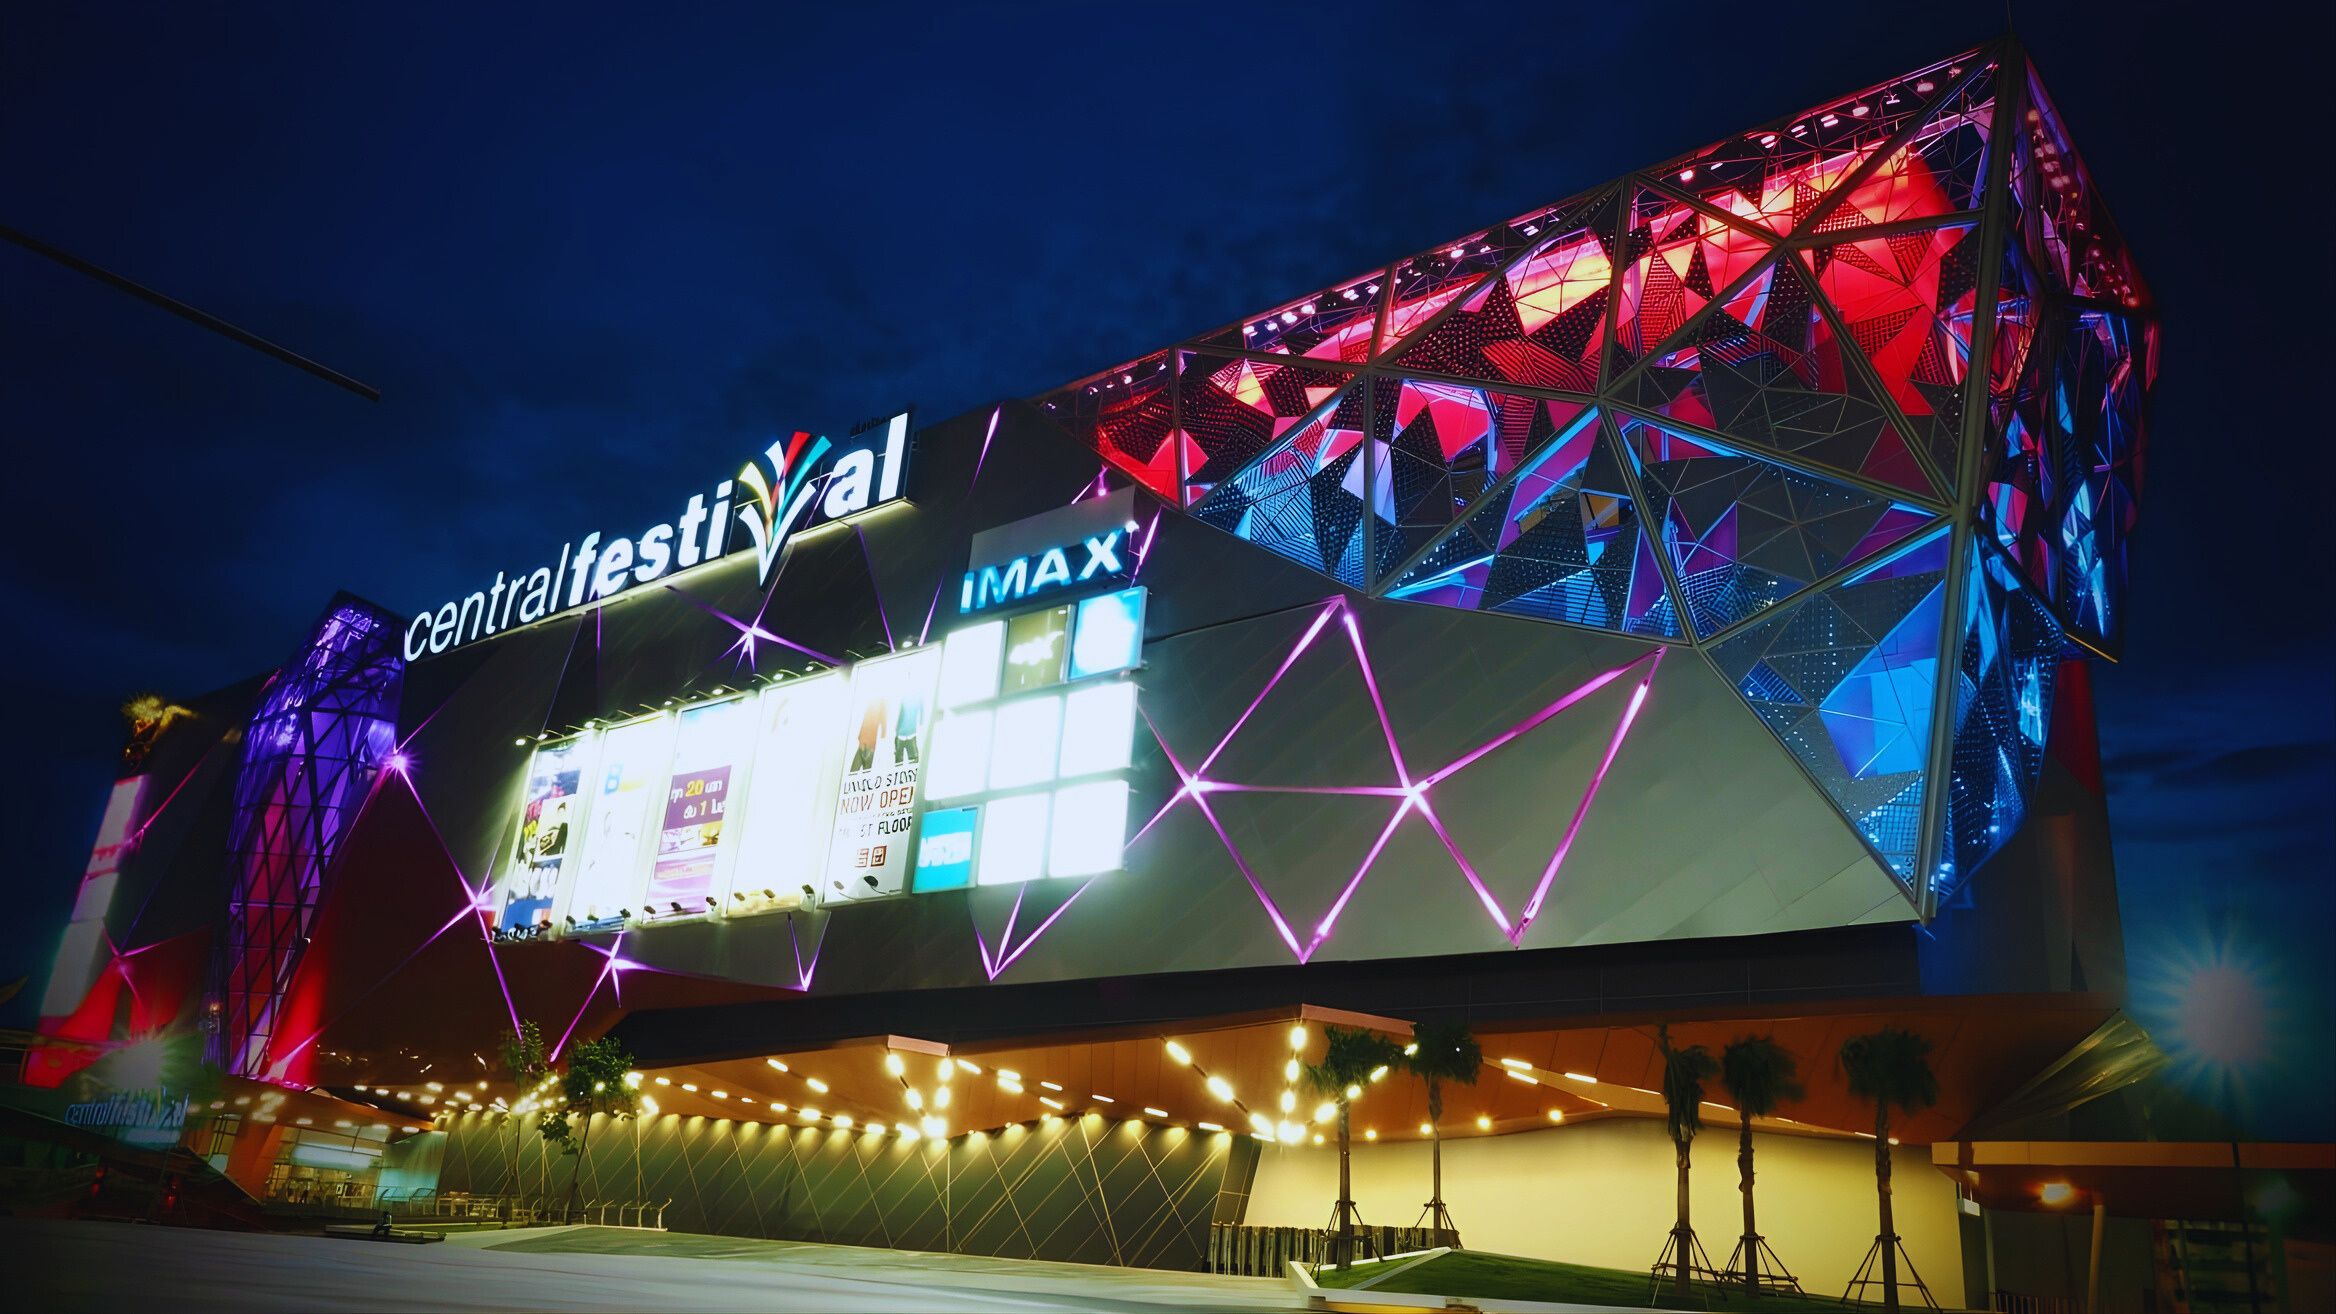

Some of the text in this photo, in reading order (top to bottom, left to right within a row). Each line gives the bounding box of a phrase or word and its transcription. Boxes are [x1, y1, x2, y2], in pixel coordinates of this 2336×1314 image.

[960, 528, 1126, 613] IMAX
[685, 779, 705, 797] 20
[841, 793, 875, 815] NOW
